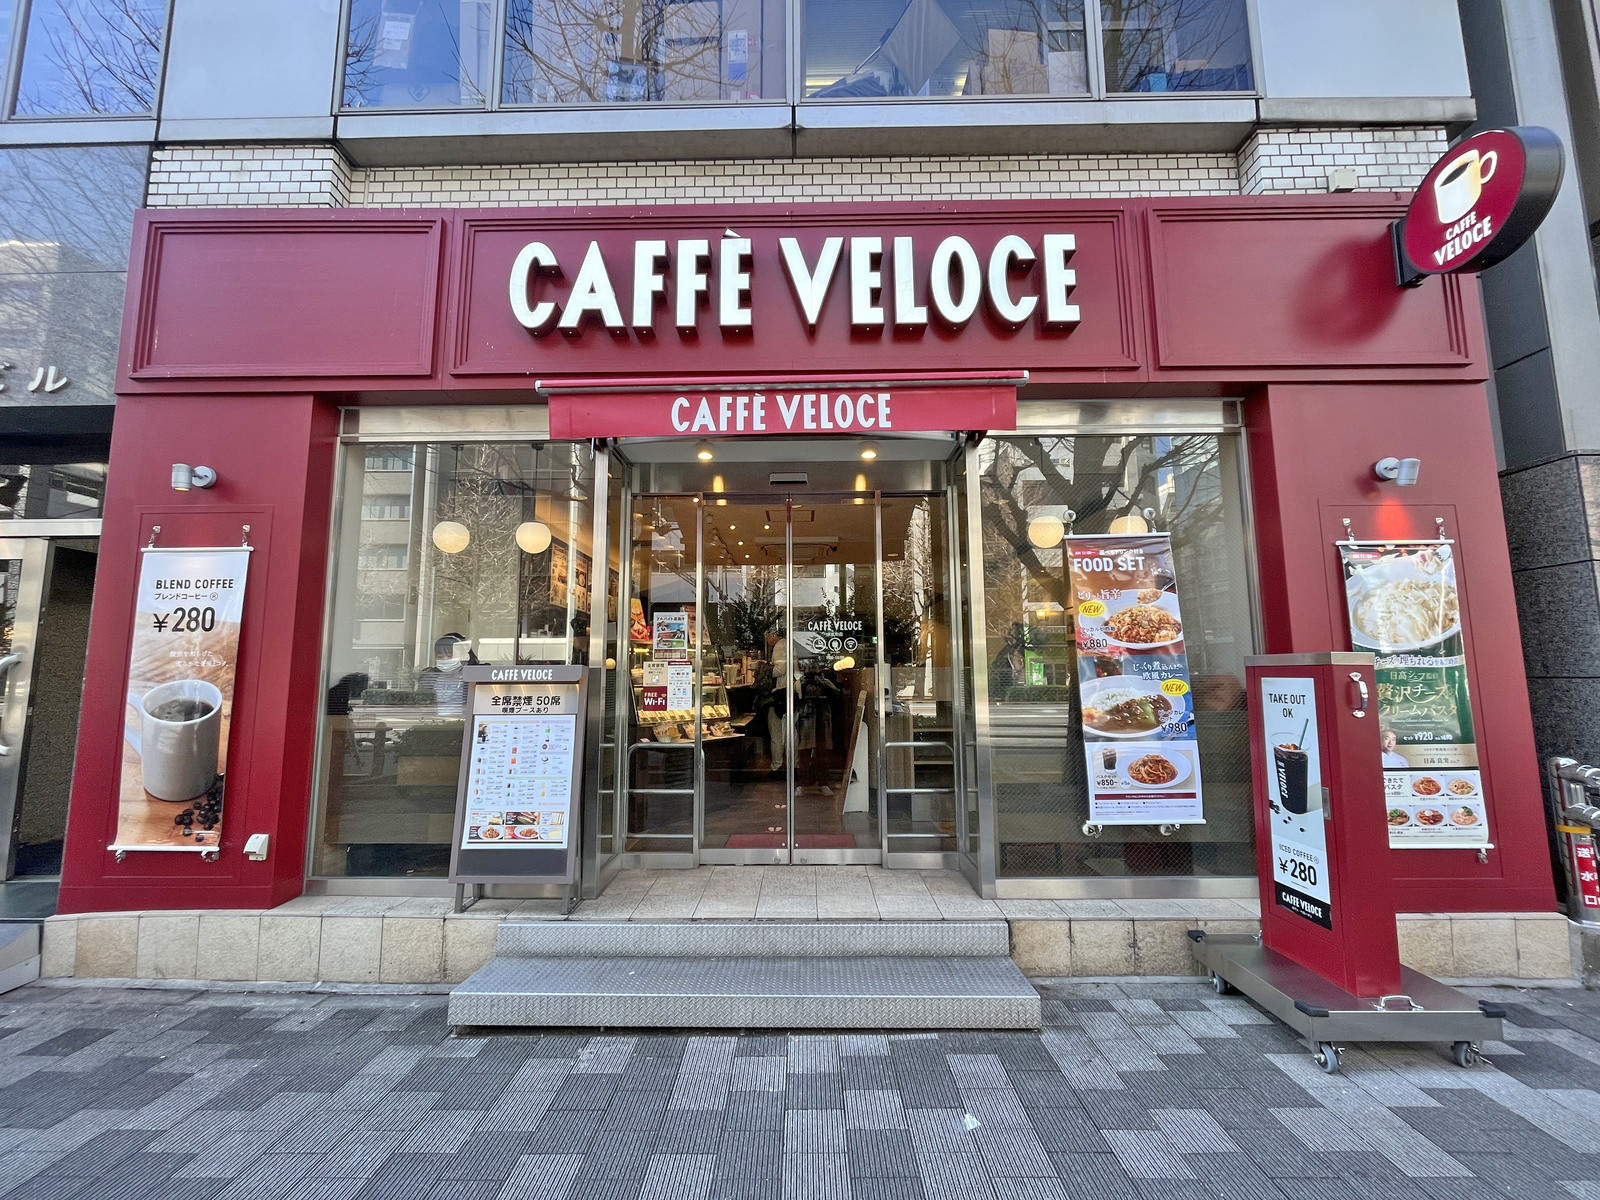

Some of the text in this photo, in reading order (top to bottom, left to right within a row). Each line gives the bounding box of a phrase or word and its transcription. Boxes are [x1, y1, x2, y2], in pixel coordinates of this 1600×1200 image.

[1433, 216, 1493, 266] VELOCE
[509, 228, 1081, 330] CAFFÈ VELOCE
[671, 393, 892, 432] CAFFÈ VELOCE
[1073, 556, 1145, 573] FOOD SET
[155, 578, 235, 590] BLEND COFFEE
[154, 592, 208, 601] ブレンドコーヒー
[1081, 604, 1103, 615] NEW
[153, 606, 216, 633] ¥280
[833, 620, 863, 631] VELOCE
[1083, 639, 1109, 649] ¥880
[521, 669, 553, 680] VELOCE
[1142, 671, 1184, 680] 欧風カレー
[1163, 683, 1185, 692] NEW
[491, 695, 561, 707] 全席禁煙 50席
[643, 697, 666, 706] Wi-Fi
[1268, 693, 1306, 705] TAKE OUT
[501, 706, 549, 714] 喫煙ブースあり
[1282, 707, 1294, 718] OK
[1161, 722, 1187, 732] ¥980
[1278, 844, 1291, 854] ICED
[1292, 848, 1313, 862] COFFEE
[1278, 856, 1318, 887] ¥280
[1300, 898, 1323, 919] VELOCE
